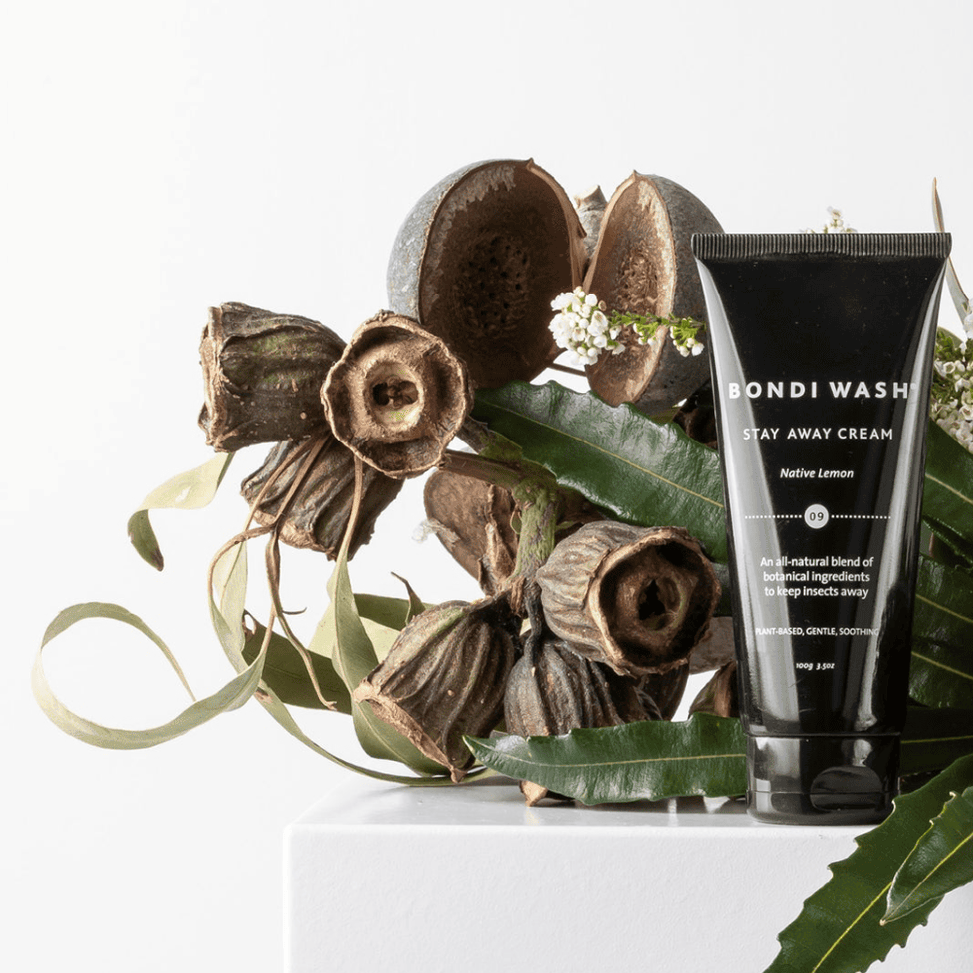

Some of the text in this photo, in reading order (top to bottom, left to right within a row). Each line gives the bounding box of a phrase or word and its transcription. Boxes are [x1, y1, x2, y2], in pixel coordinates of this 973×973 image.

[728, 381, 818, 399] BONDI
[743, 427, 893, 440] STAY AWAY CREAM
[780, 468, 854, 478] Native Lemon
[809, 512, 824, 521] 09
[760, 556, 874, 567] An all-natural blend of
[763, 571, 870, 584] botanical ingredients
[764, 586, 869, 599] to keep insects away
[755, 627, 879, 636] PLANT-BASED, GENTLE, SOOTHING
[796, 662, 835, 671] 100g 3.5oz
